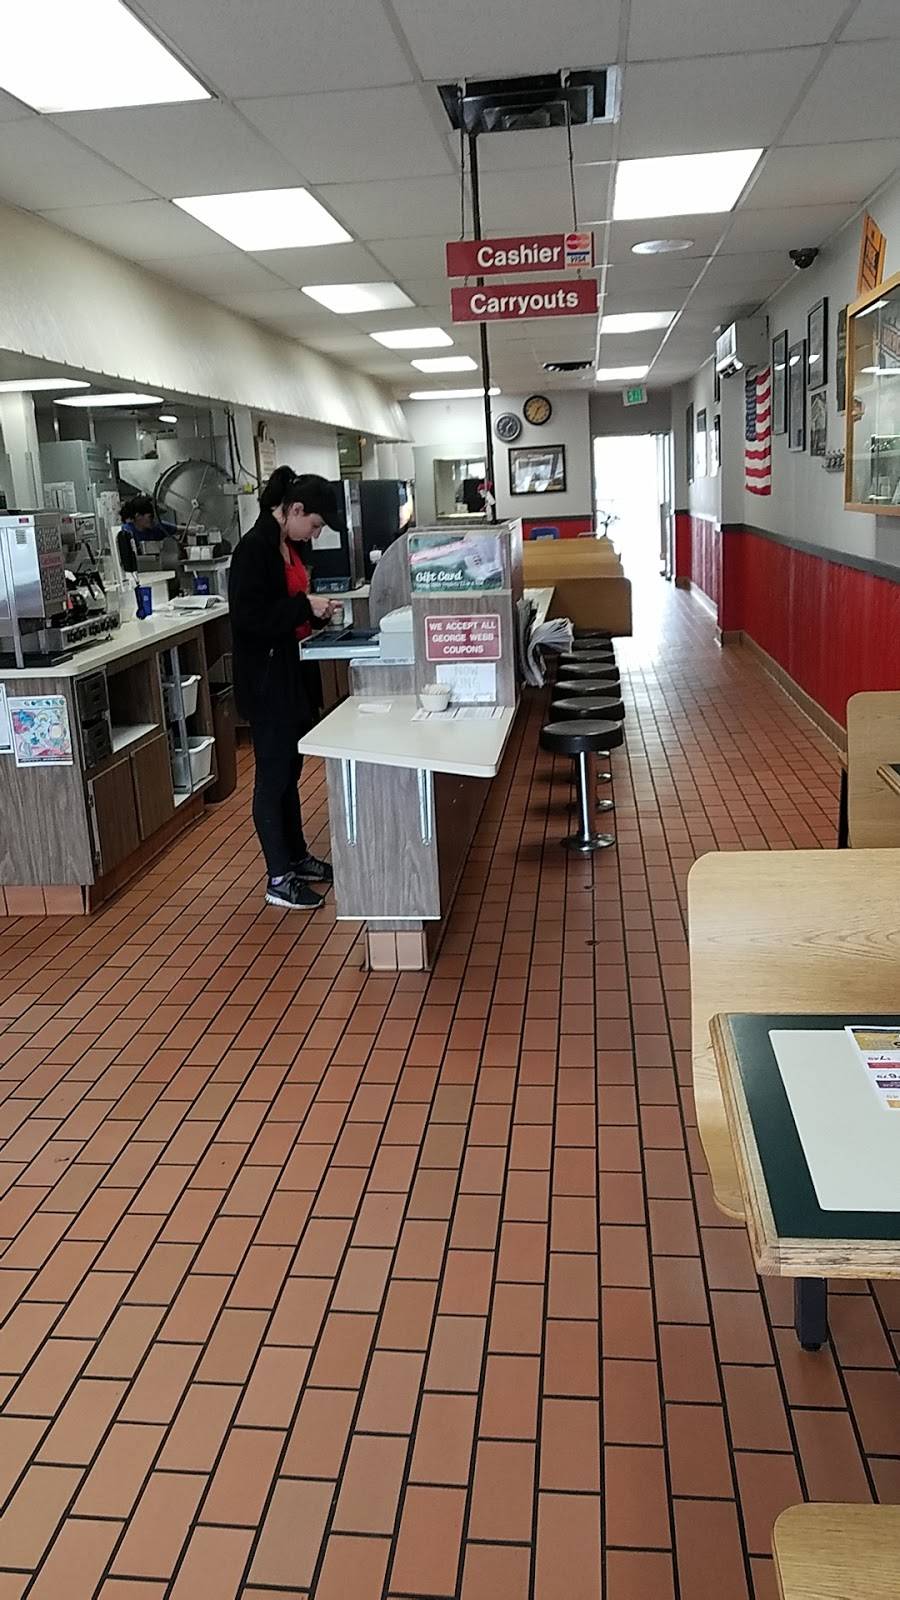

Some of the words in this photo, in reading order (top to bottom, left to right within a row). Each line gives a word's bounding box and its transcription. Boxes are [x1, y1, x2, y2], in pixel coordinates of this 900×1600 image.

[477, 243, 562, 268] Cashier
[569, 255, 587, 263] VISA
[470, 289, 578, 315] Carryouts
[415, 571, 437, 584] Gift
[437, 569, 464, 582] Card
[429, 622, 442, 631] WE
[445, 621, 478, 631] ACCEPT
[481, 621, 497, 630] ALL
[432, 633, 467, 643] GEORGE
[469, 633, 495, 642] WEBB
[443, 645, 484, 655] COUPONS
